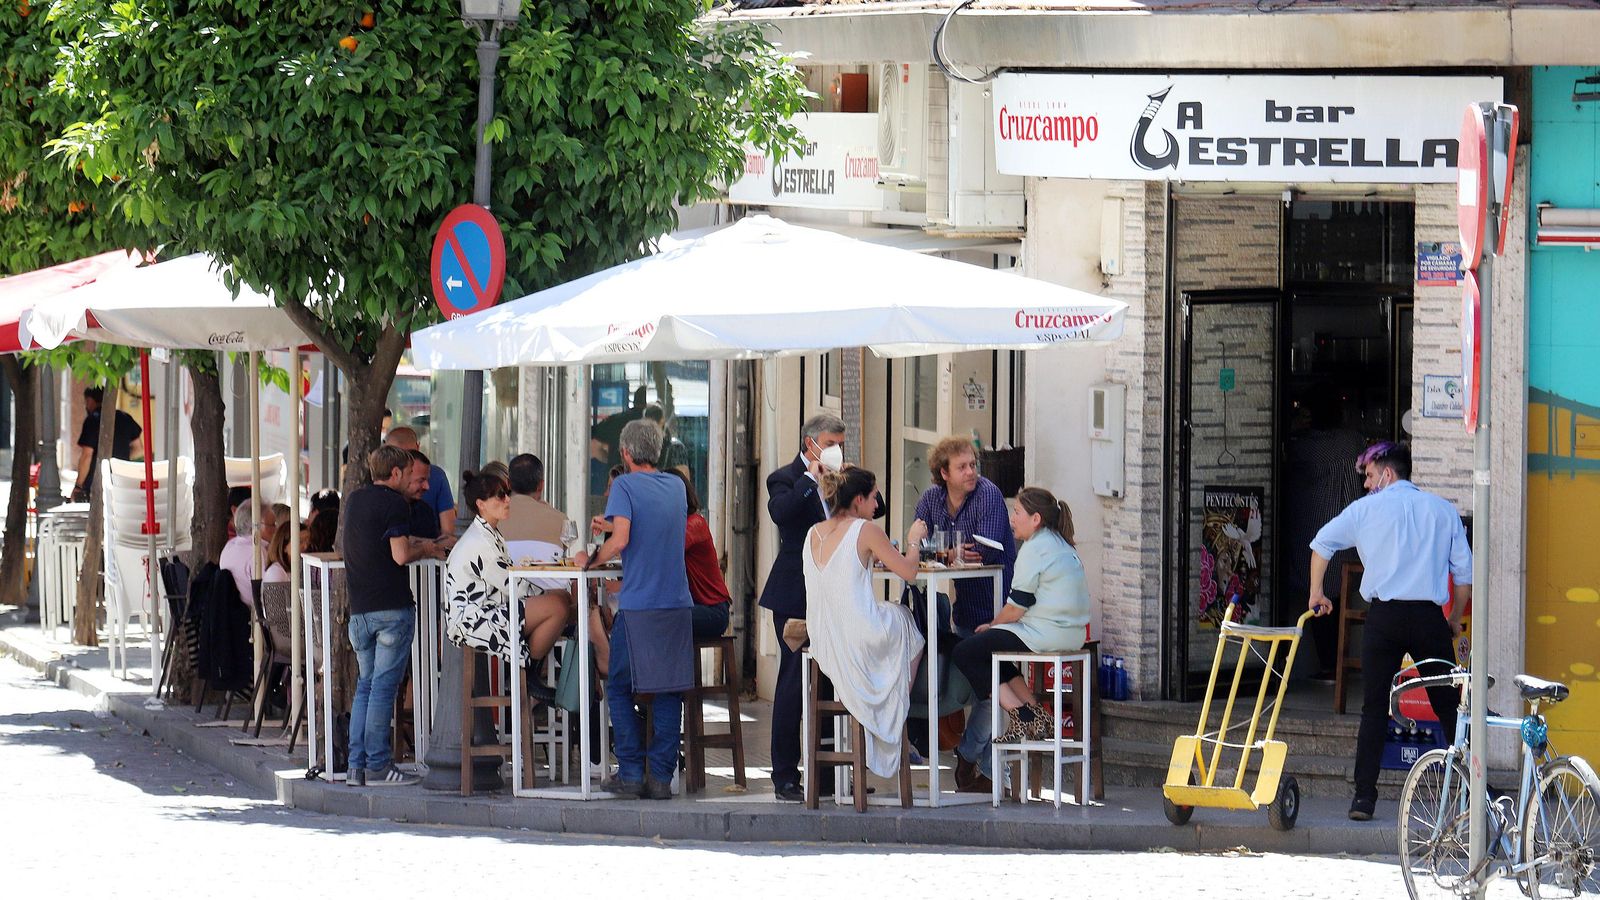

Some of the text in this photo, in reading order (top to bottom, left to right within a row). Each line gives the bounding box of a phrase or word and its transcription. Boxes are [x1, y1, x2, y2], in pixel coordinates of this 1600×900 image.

[1265, 99, 1355, 123] bar
[999, 104, 1099, 148] Cruzcampo
[1188, 136, 1460, 168] ESTRELLA
[783, 168, 835, 195] ESTRELLA
[1205, 492, 1259, 508] PENTECOSTÉS
